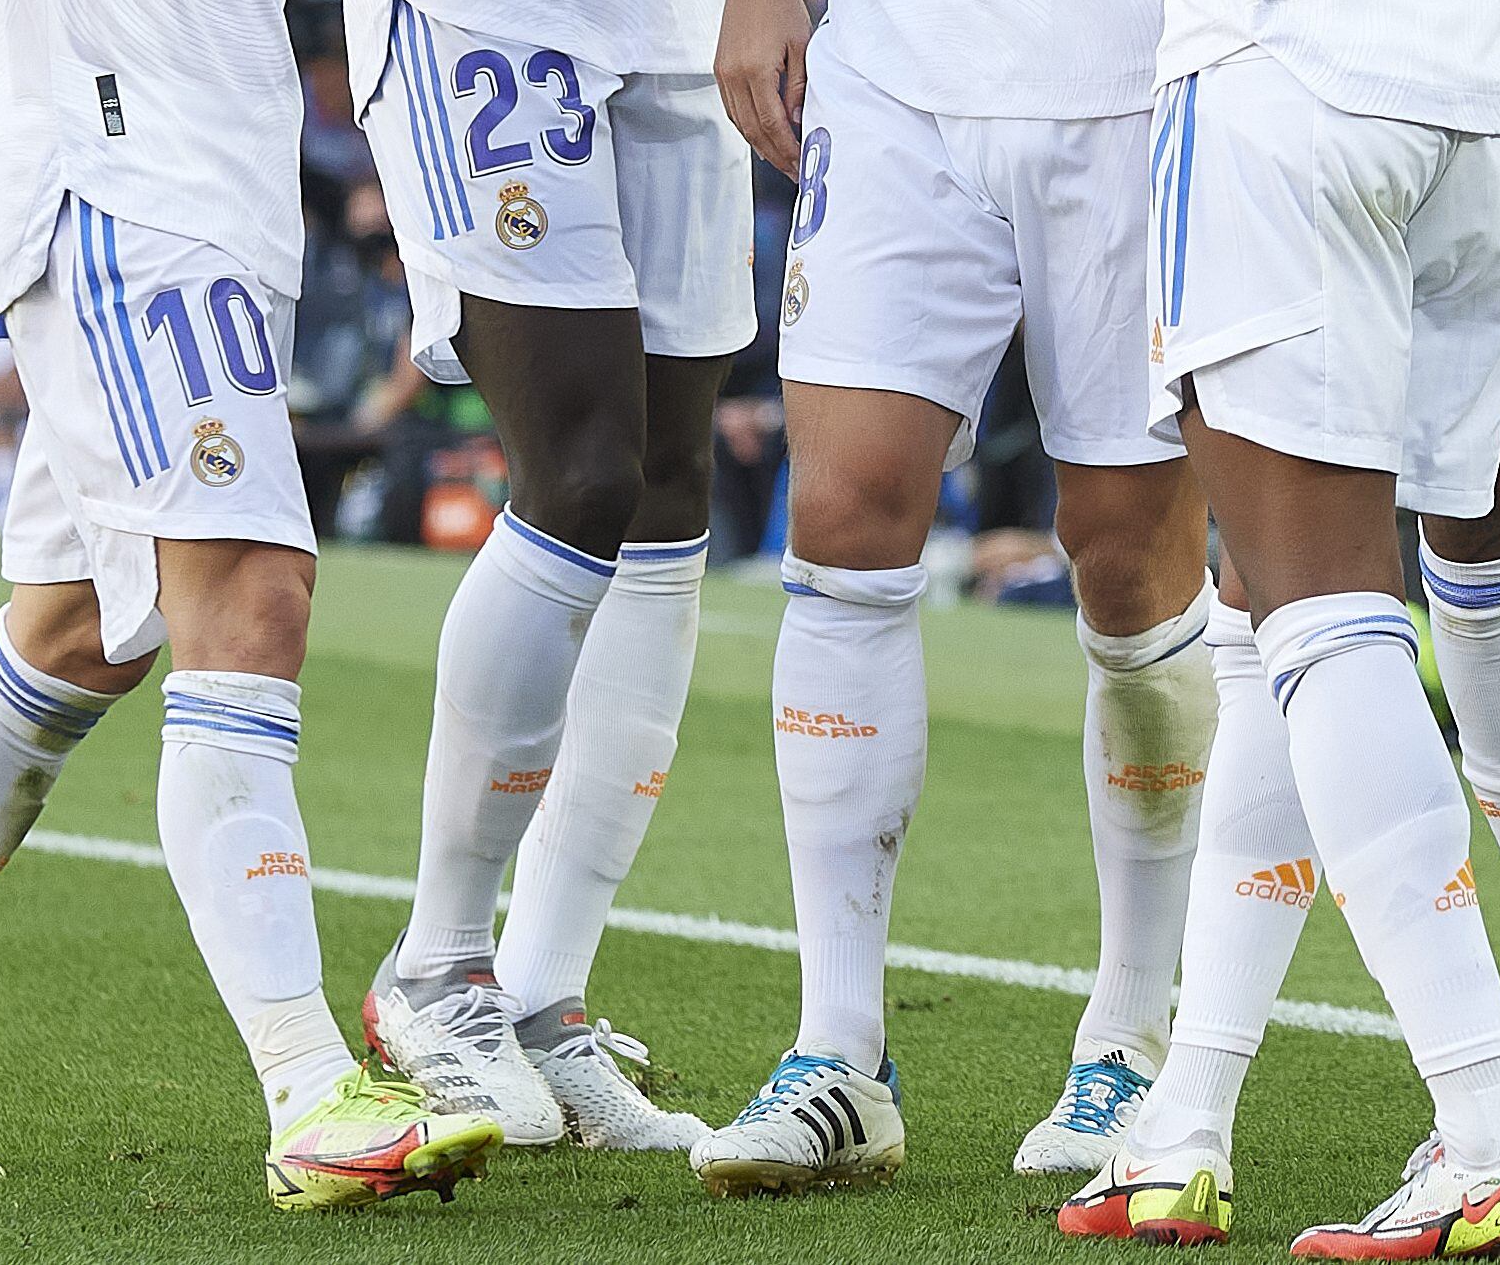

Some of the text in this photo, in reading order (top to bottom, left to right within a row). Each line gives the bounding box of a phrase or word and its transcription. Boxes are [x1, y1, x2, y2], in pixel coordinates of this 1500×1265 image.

[450, 48, 597, 180] 23
[791, 126, 832, 251] 8
[140, 276, 278, 408] 10
[783, 705, 855, 726] REAL
[775, 717, 879, 739] MADRID
[508, 767, 553, 783] REA
[260, 851, 305, 865] REA
[246, 864, 309, 880] MADR
[1435, 889, 1479, 912] adi
